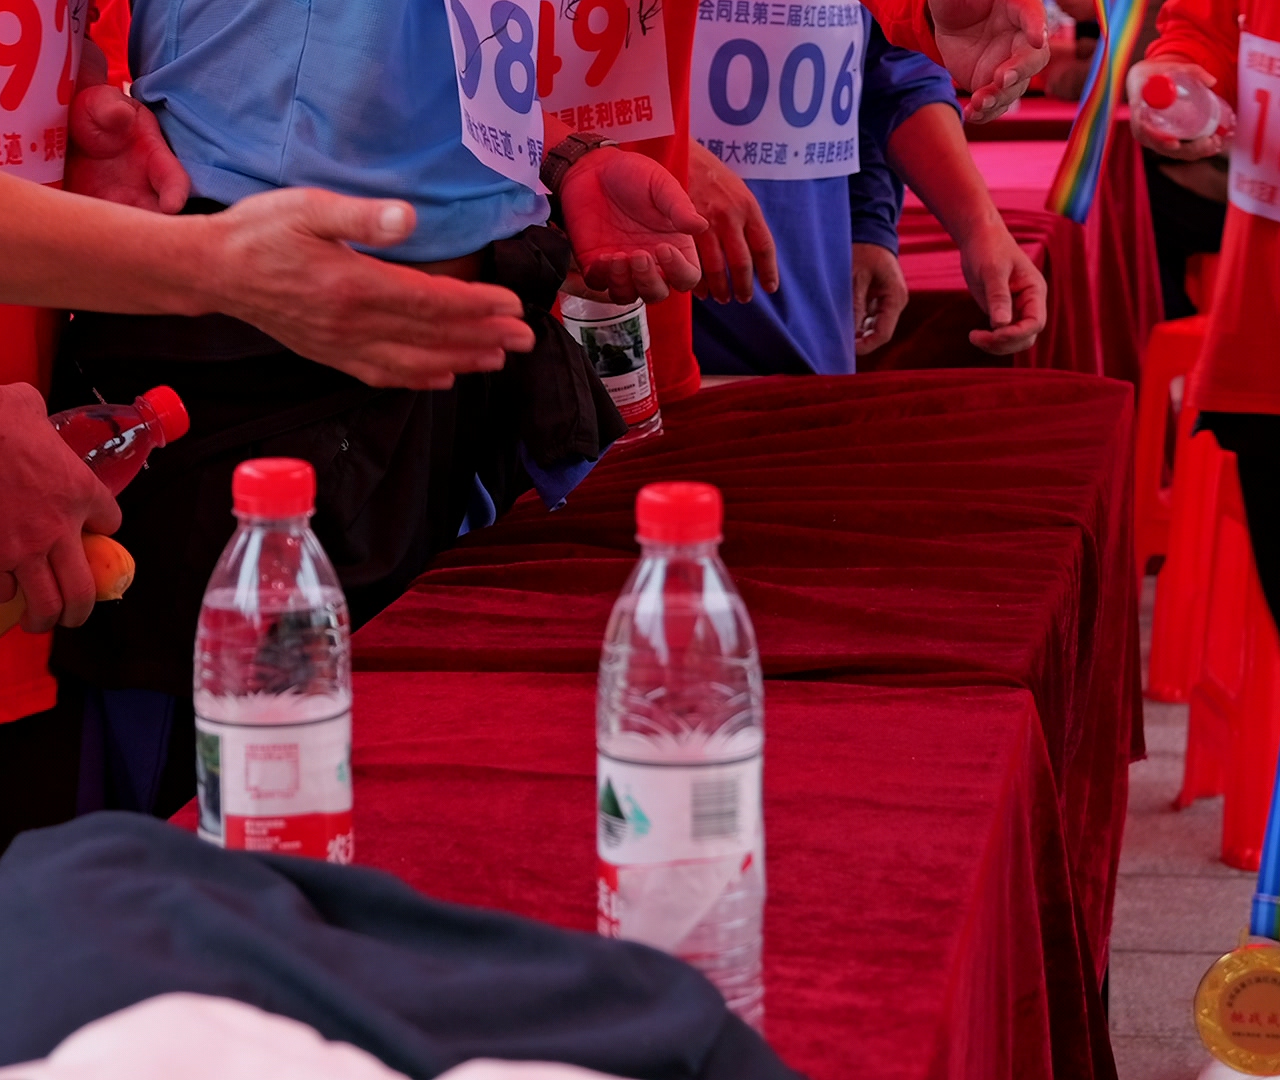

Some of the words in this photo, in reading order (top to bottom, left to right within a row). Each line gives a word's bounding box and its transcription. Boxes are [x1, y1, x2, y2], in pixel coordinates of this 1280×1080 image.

[549, 95, 654, 132] 寻胜利密码
[707, 38, 854, 128] 006
